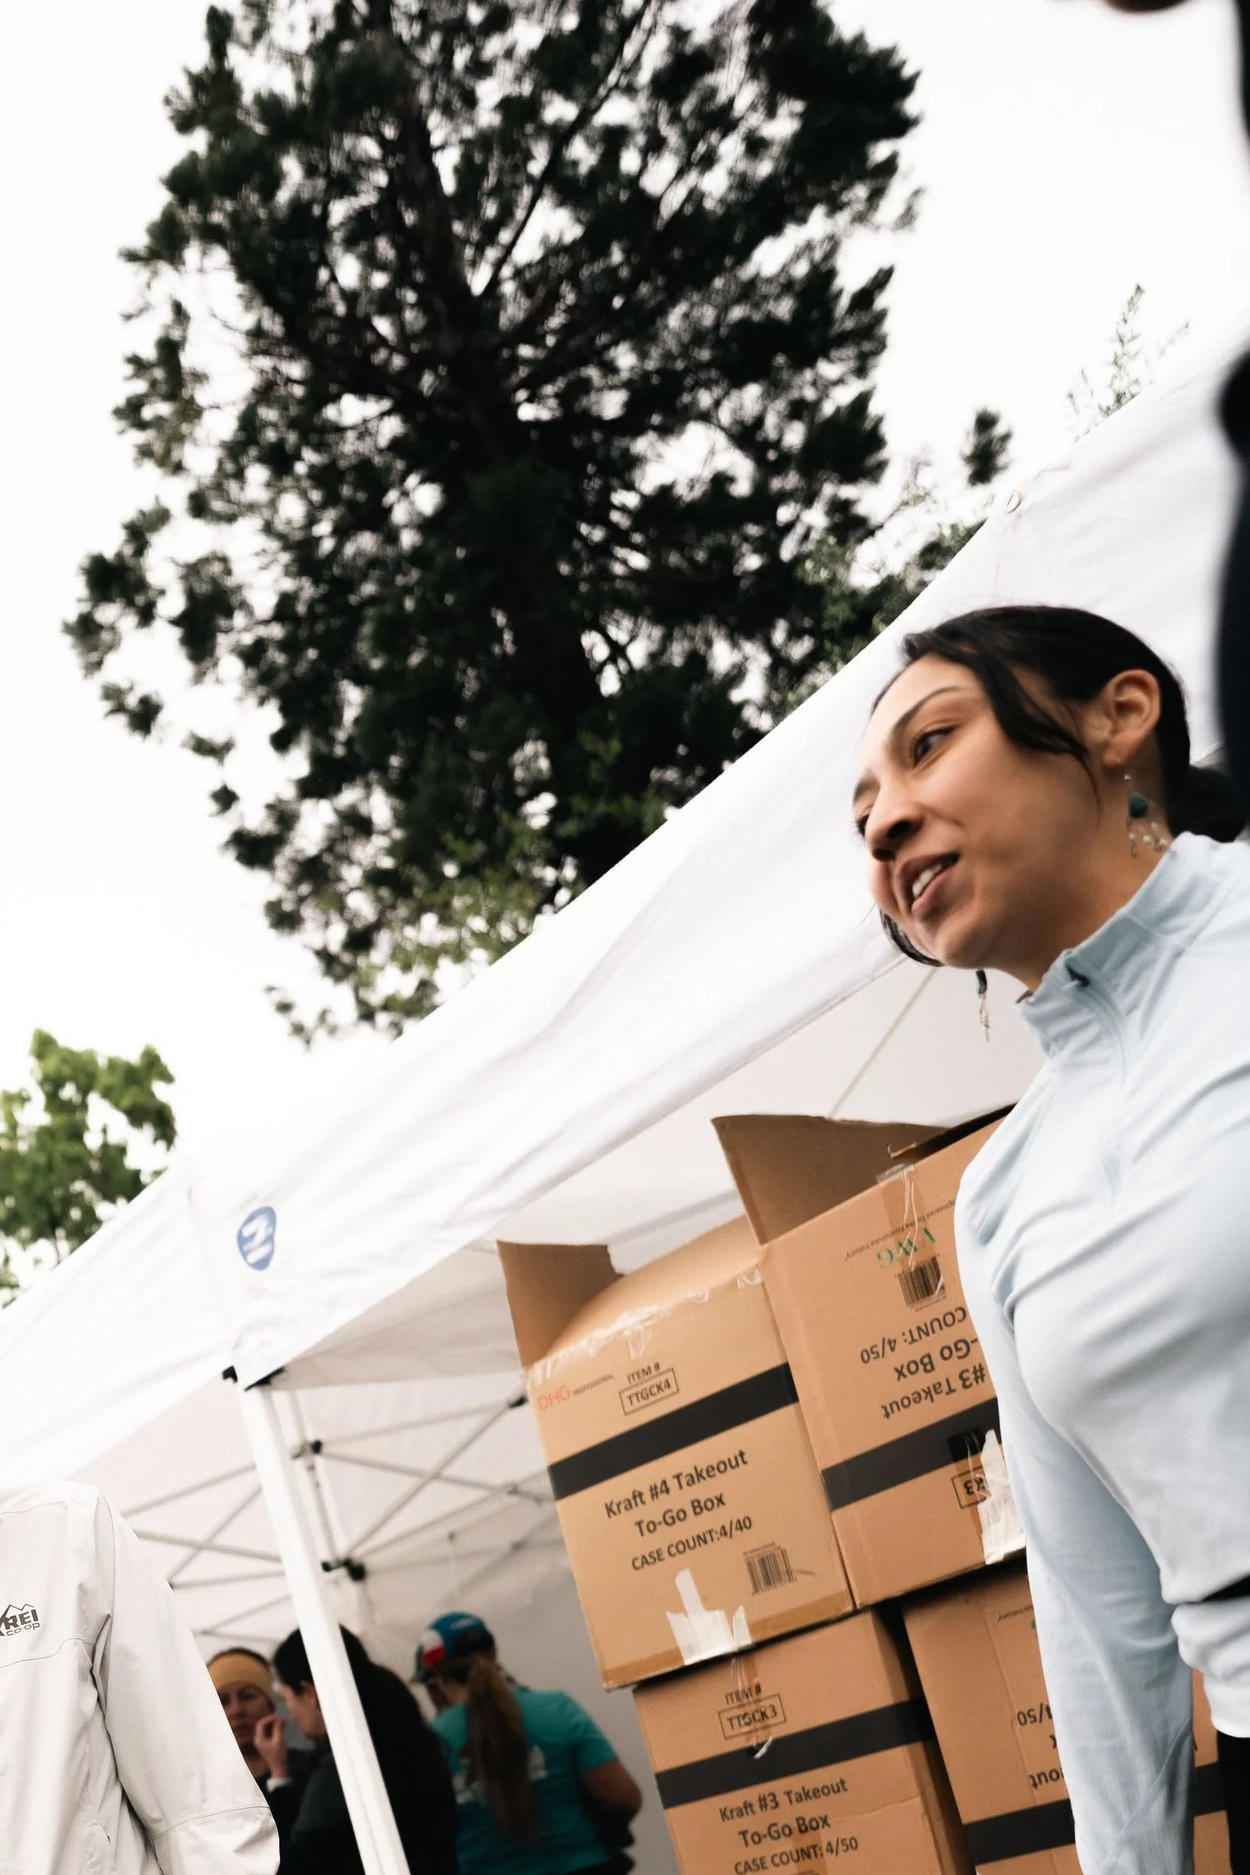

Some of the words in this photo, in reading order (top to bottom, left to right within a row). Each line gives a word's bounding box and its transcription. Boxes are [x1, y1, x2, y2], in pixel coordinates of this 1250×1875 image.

[902, 1306, 967, 1345] COUNT:
[860, 1337, 897, 1364] 4/50
[627, 1366, 652, 1385] ITEM
[894, 1353, 936, 1382] Box
[958, 1362, 986, 1390] #3
[626, 1379, 672, 1406] TTGCK4
[881, 1377, 956, 1419] Takeout
[604, 1489, 646, 1519] Kraft
[649, 1480, 670, 1501] #4
[672, 1449, 748, 1490] Takeout
[634, 1508, 687, 1537] To-Go
[690, 1493, 726, 1517] Box
[632, 1548, 665, 1571] CASE
[3, 1609, 39, 1630] REI
[1029, 1768, 1064, 1789] out
[719, 1800, 756, 1822] Kraft
[758, 1792, 779, 1812] #3
[783, 1778, 848, 1806] Takeout
[738, 1822, 793, 1848] To-Go
[796, 1814, 831, 1835] Box
[734, 1856, 767, 1875] CASE
[770, 1843, 824, 1868] COUNT:
[826, 1836, 859, 1856] 4/50
